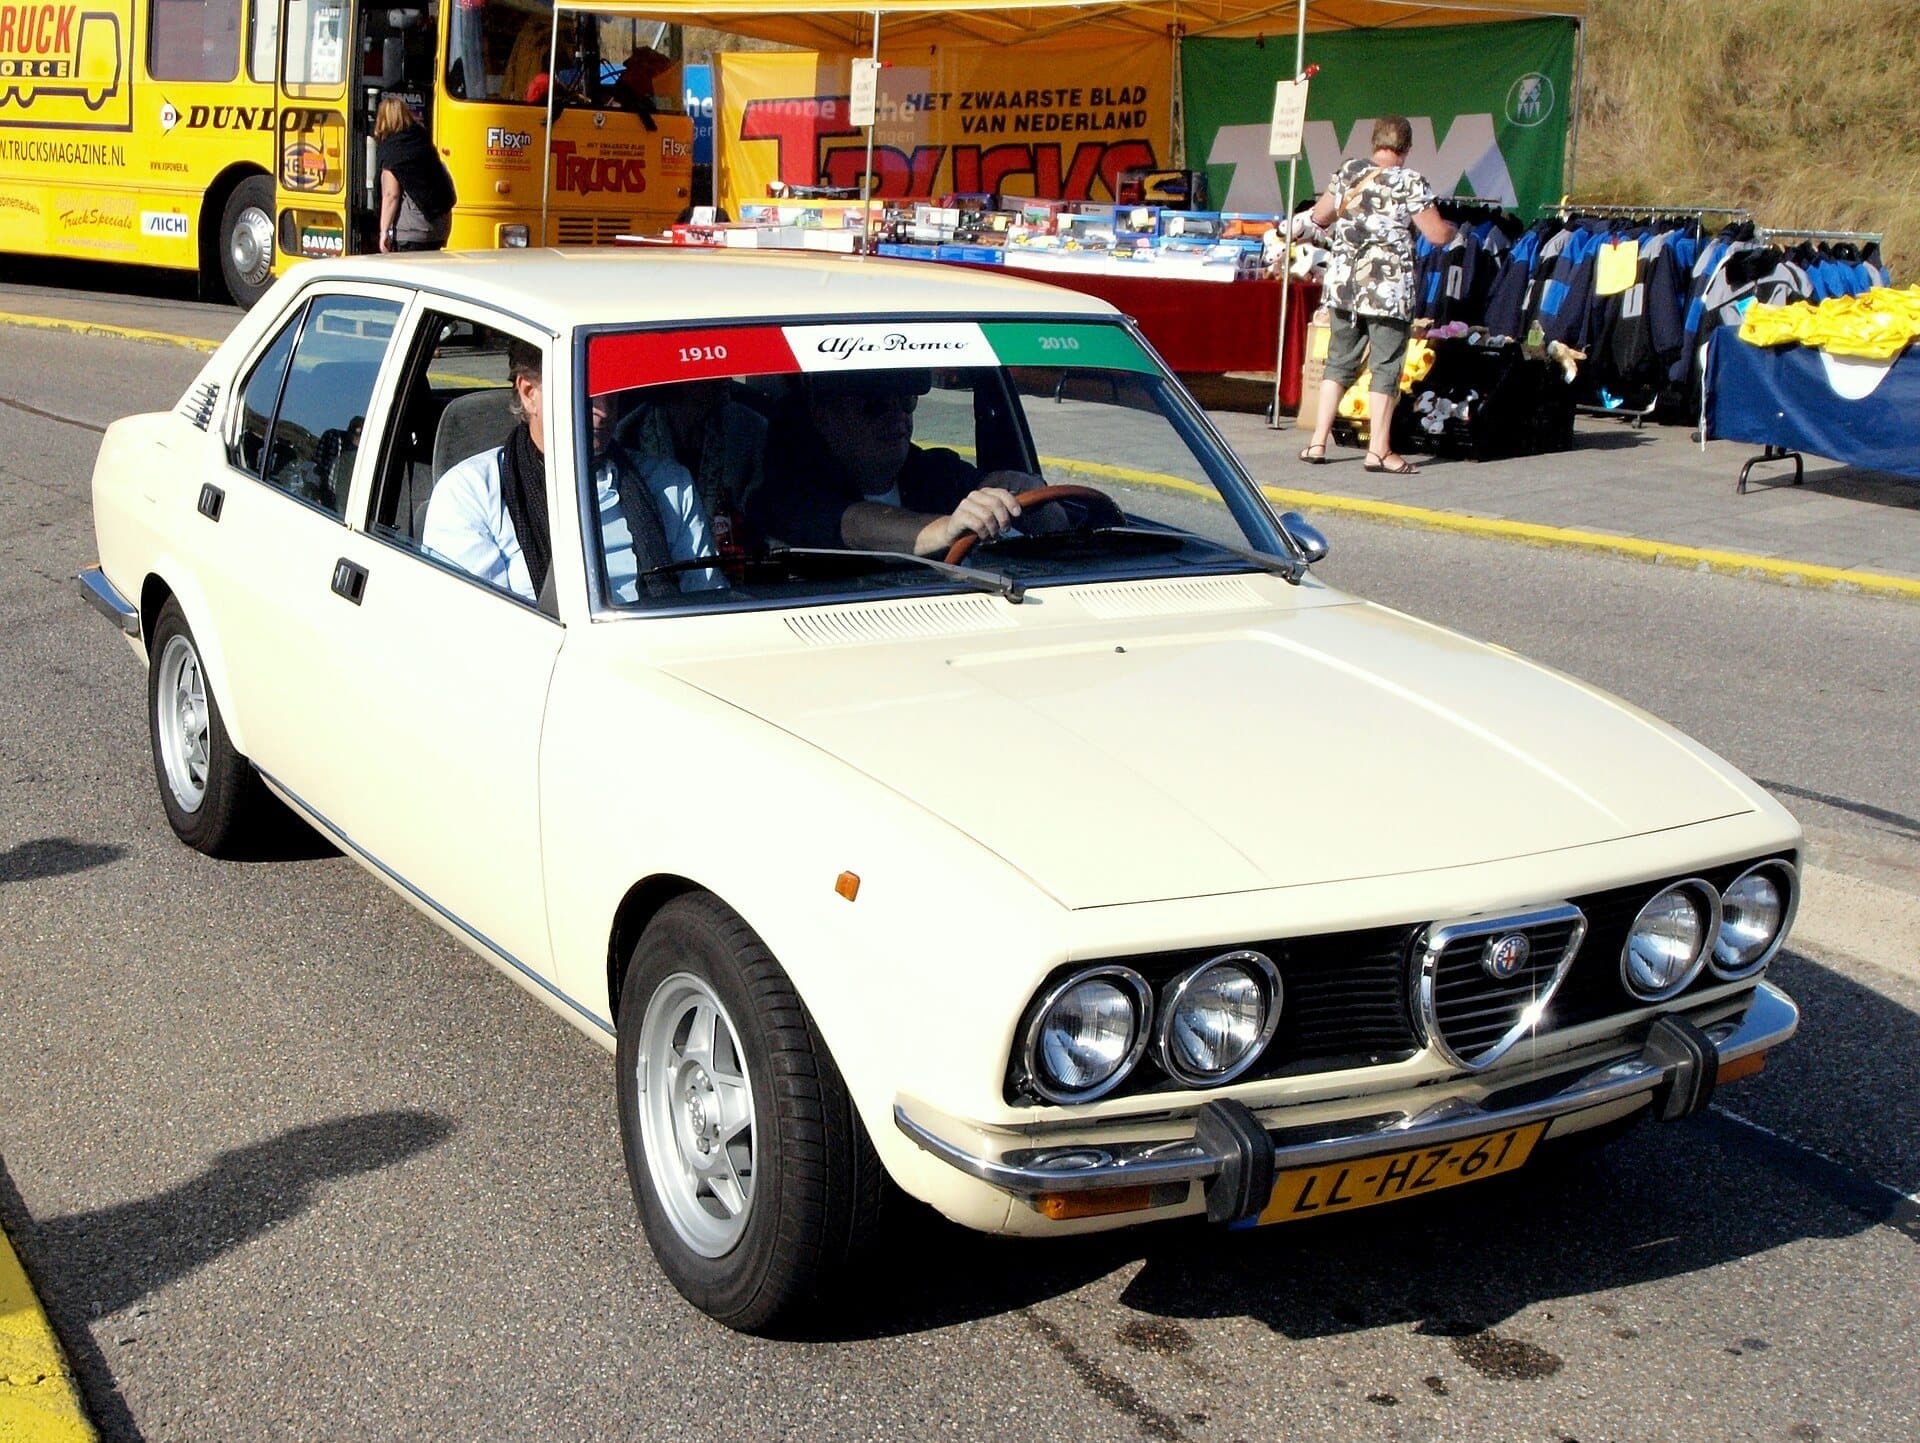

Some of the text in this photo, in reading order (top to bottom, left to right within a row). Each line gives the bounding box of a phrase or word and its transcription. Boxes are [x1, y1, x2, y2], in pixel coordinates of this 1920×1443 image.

[960, 88, 1083, 110] ZWAARSTE
[1089, 85, 1147, 107] BLAD
[962, 110, 1148, 134] VAN NEDERLAND
[551, 140, 646, 196] TRUCKS
[302, 234, 344, 250] SAVAS
[679, 345, 728, 361] 1910
[817, 333, 968, 361] Alfa Romeo
[1038, 336, 1079, 350] 2010
[1292, 1131, 1518, 1213] LL-HZ-61
